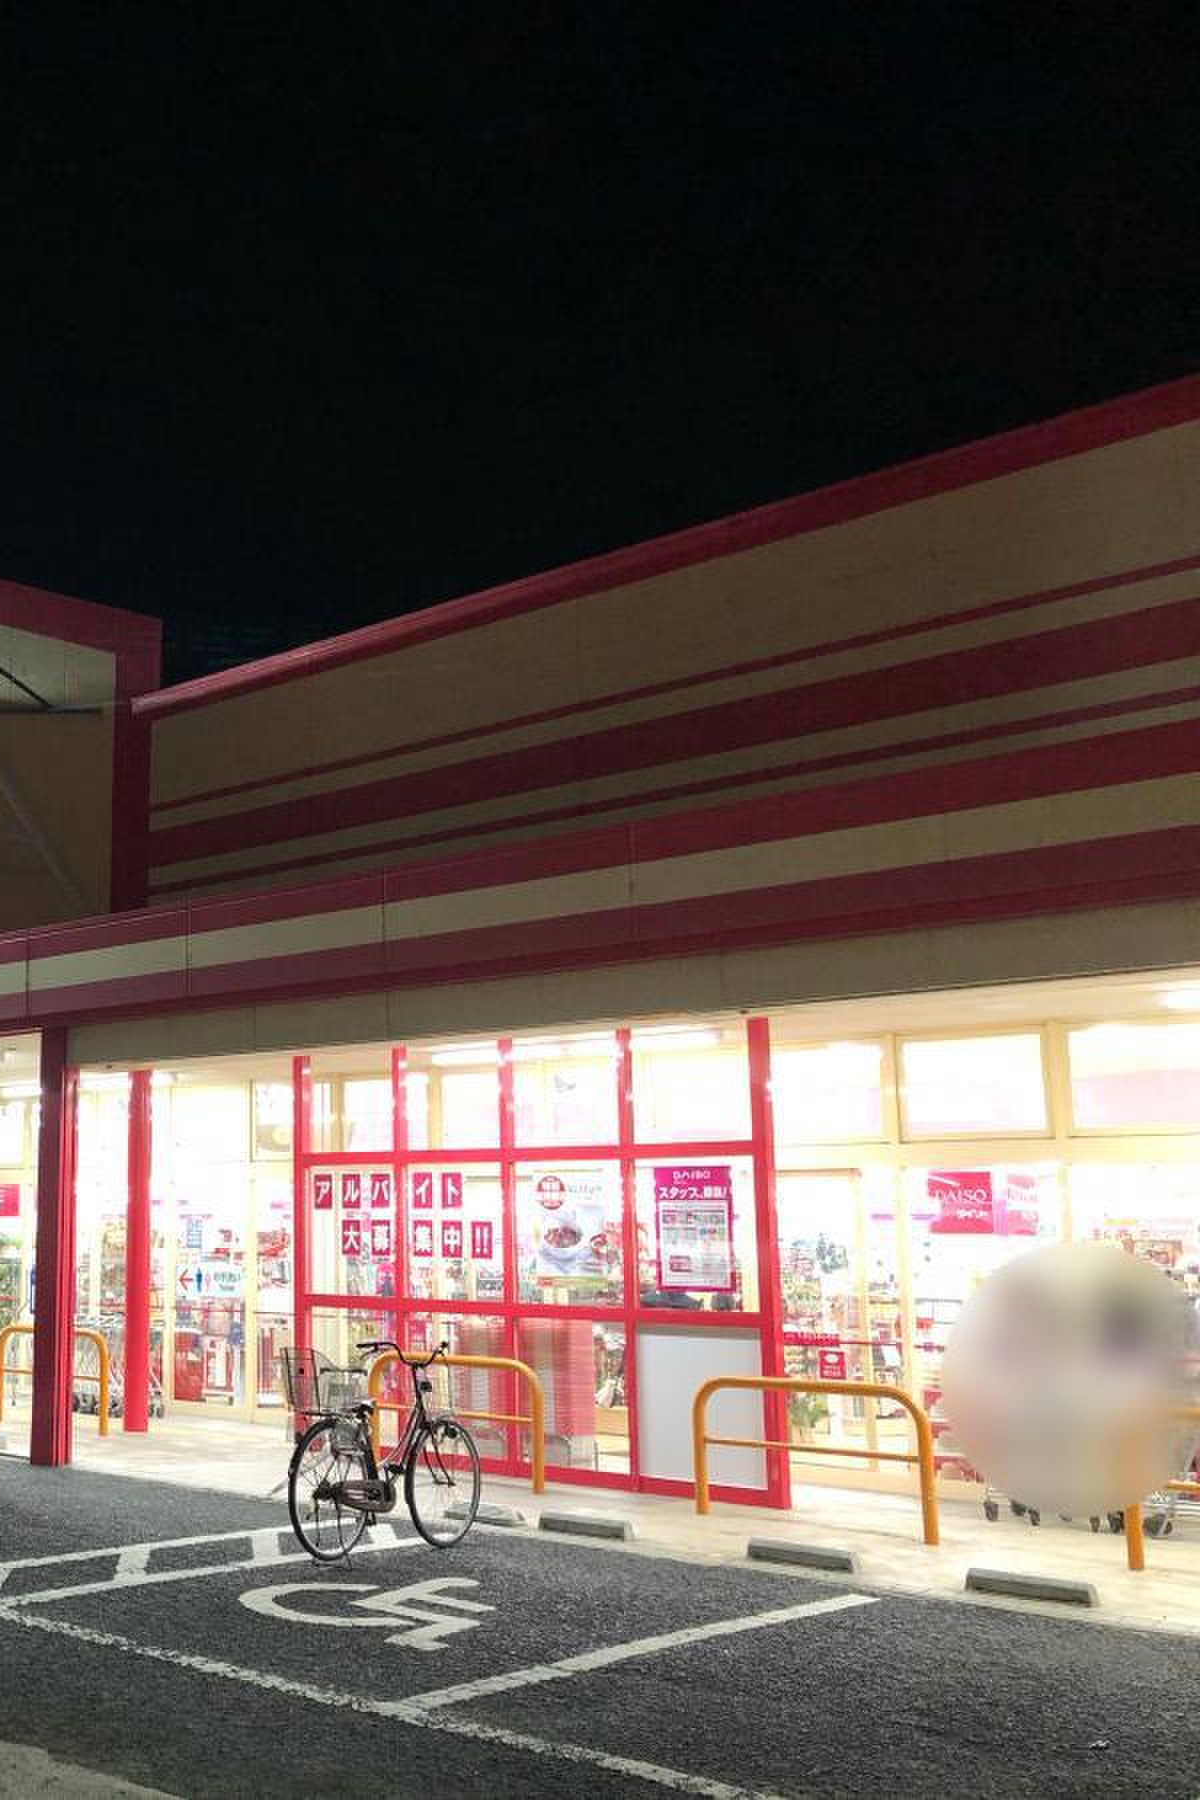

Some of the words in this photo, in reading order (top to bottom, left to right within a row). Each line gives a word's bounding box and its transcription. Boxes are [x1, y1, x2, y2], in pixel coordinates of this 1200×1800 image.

[315, 1176, 461, 1205] アルバイト
